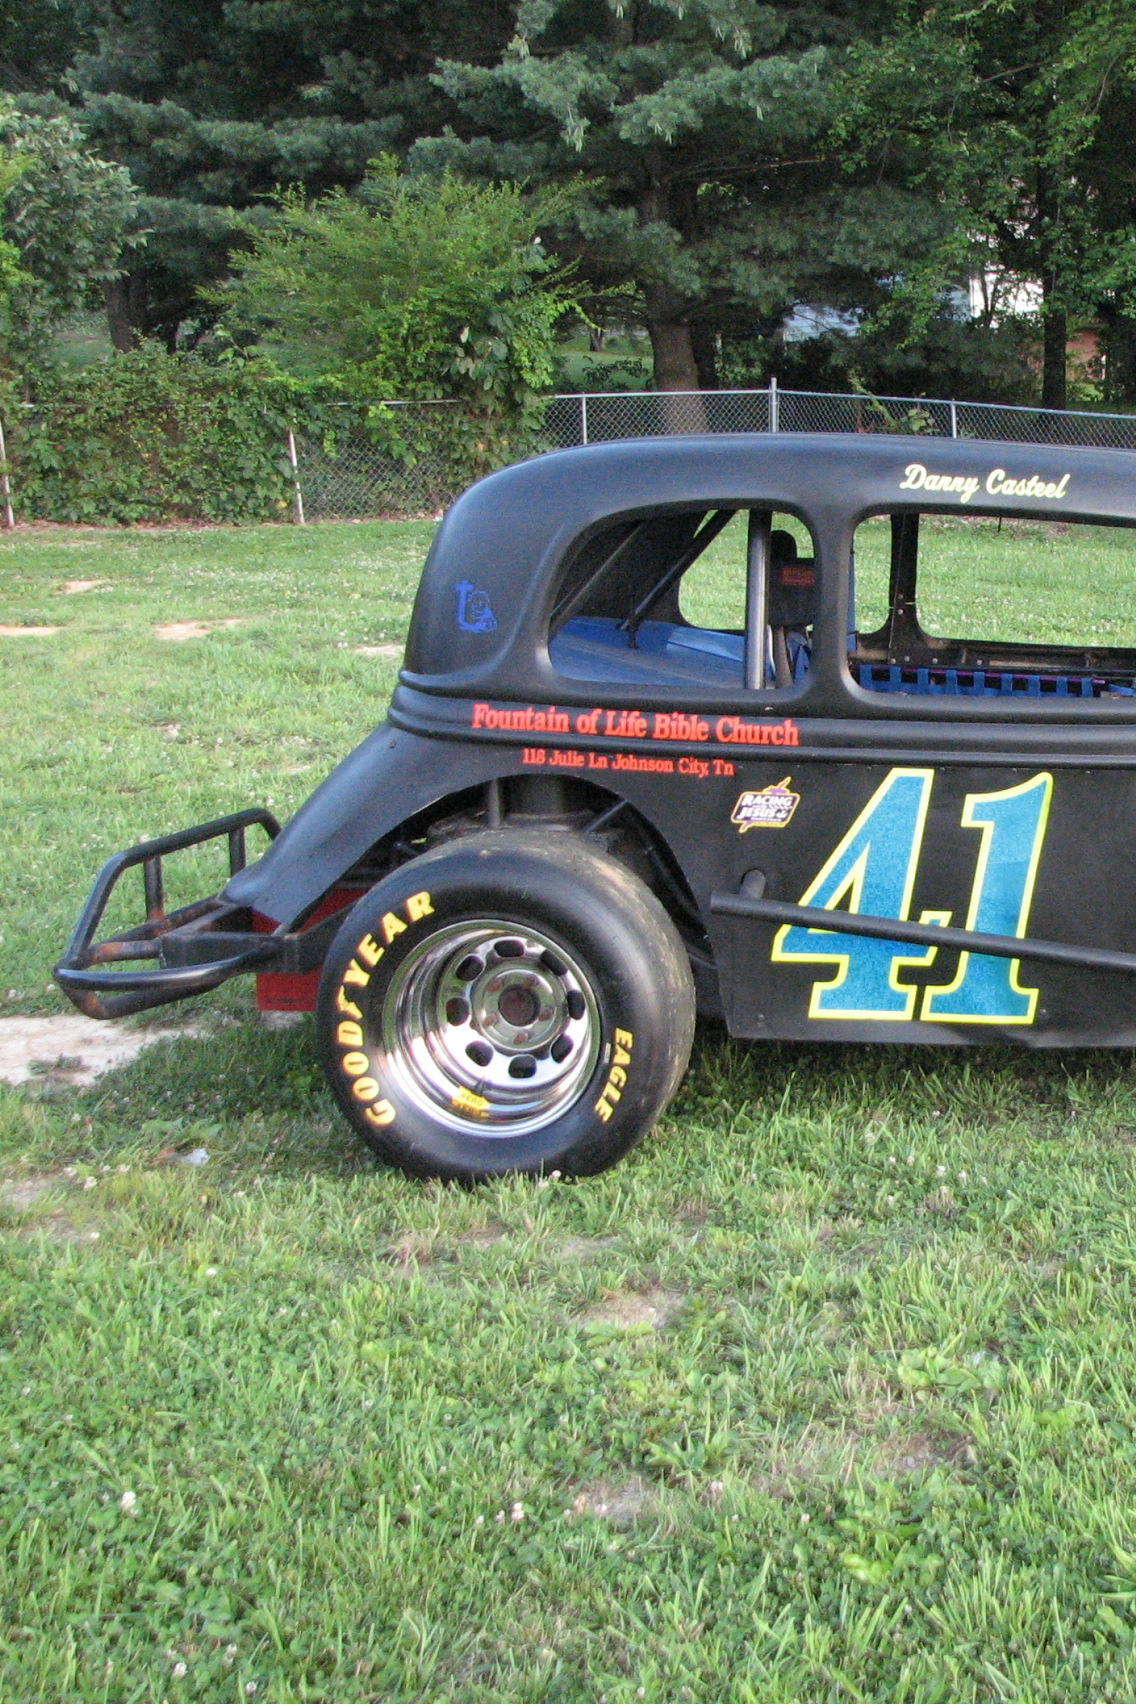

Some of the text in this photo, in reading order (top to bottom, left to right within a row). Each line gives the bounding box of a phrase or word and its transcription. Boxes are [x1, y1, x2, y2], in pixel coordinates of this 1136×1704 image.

[899, 463, 1071, 504] Danny Casteel
[471, 703, 800, 746] Fountain of Life Bible Church
[522, 748, 735, 778] 118 Julie Ln Johnson City, Tn
[741, 795, 793, 806] RACING
[771, 768, 1053, 1024] 41
[337, 891, 435, 1125] GOODYEAR
[594, 1028, 634, 1122] EAGLE
